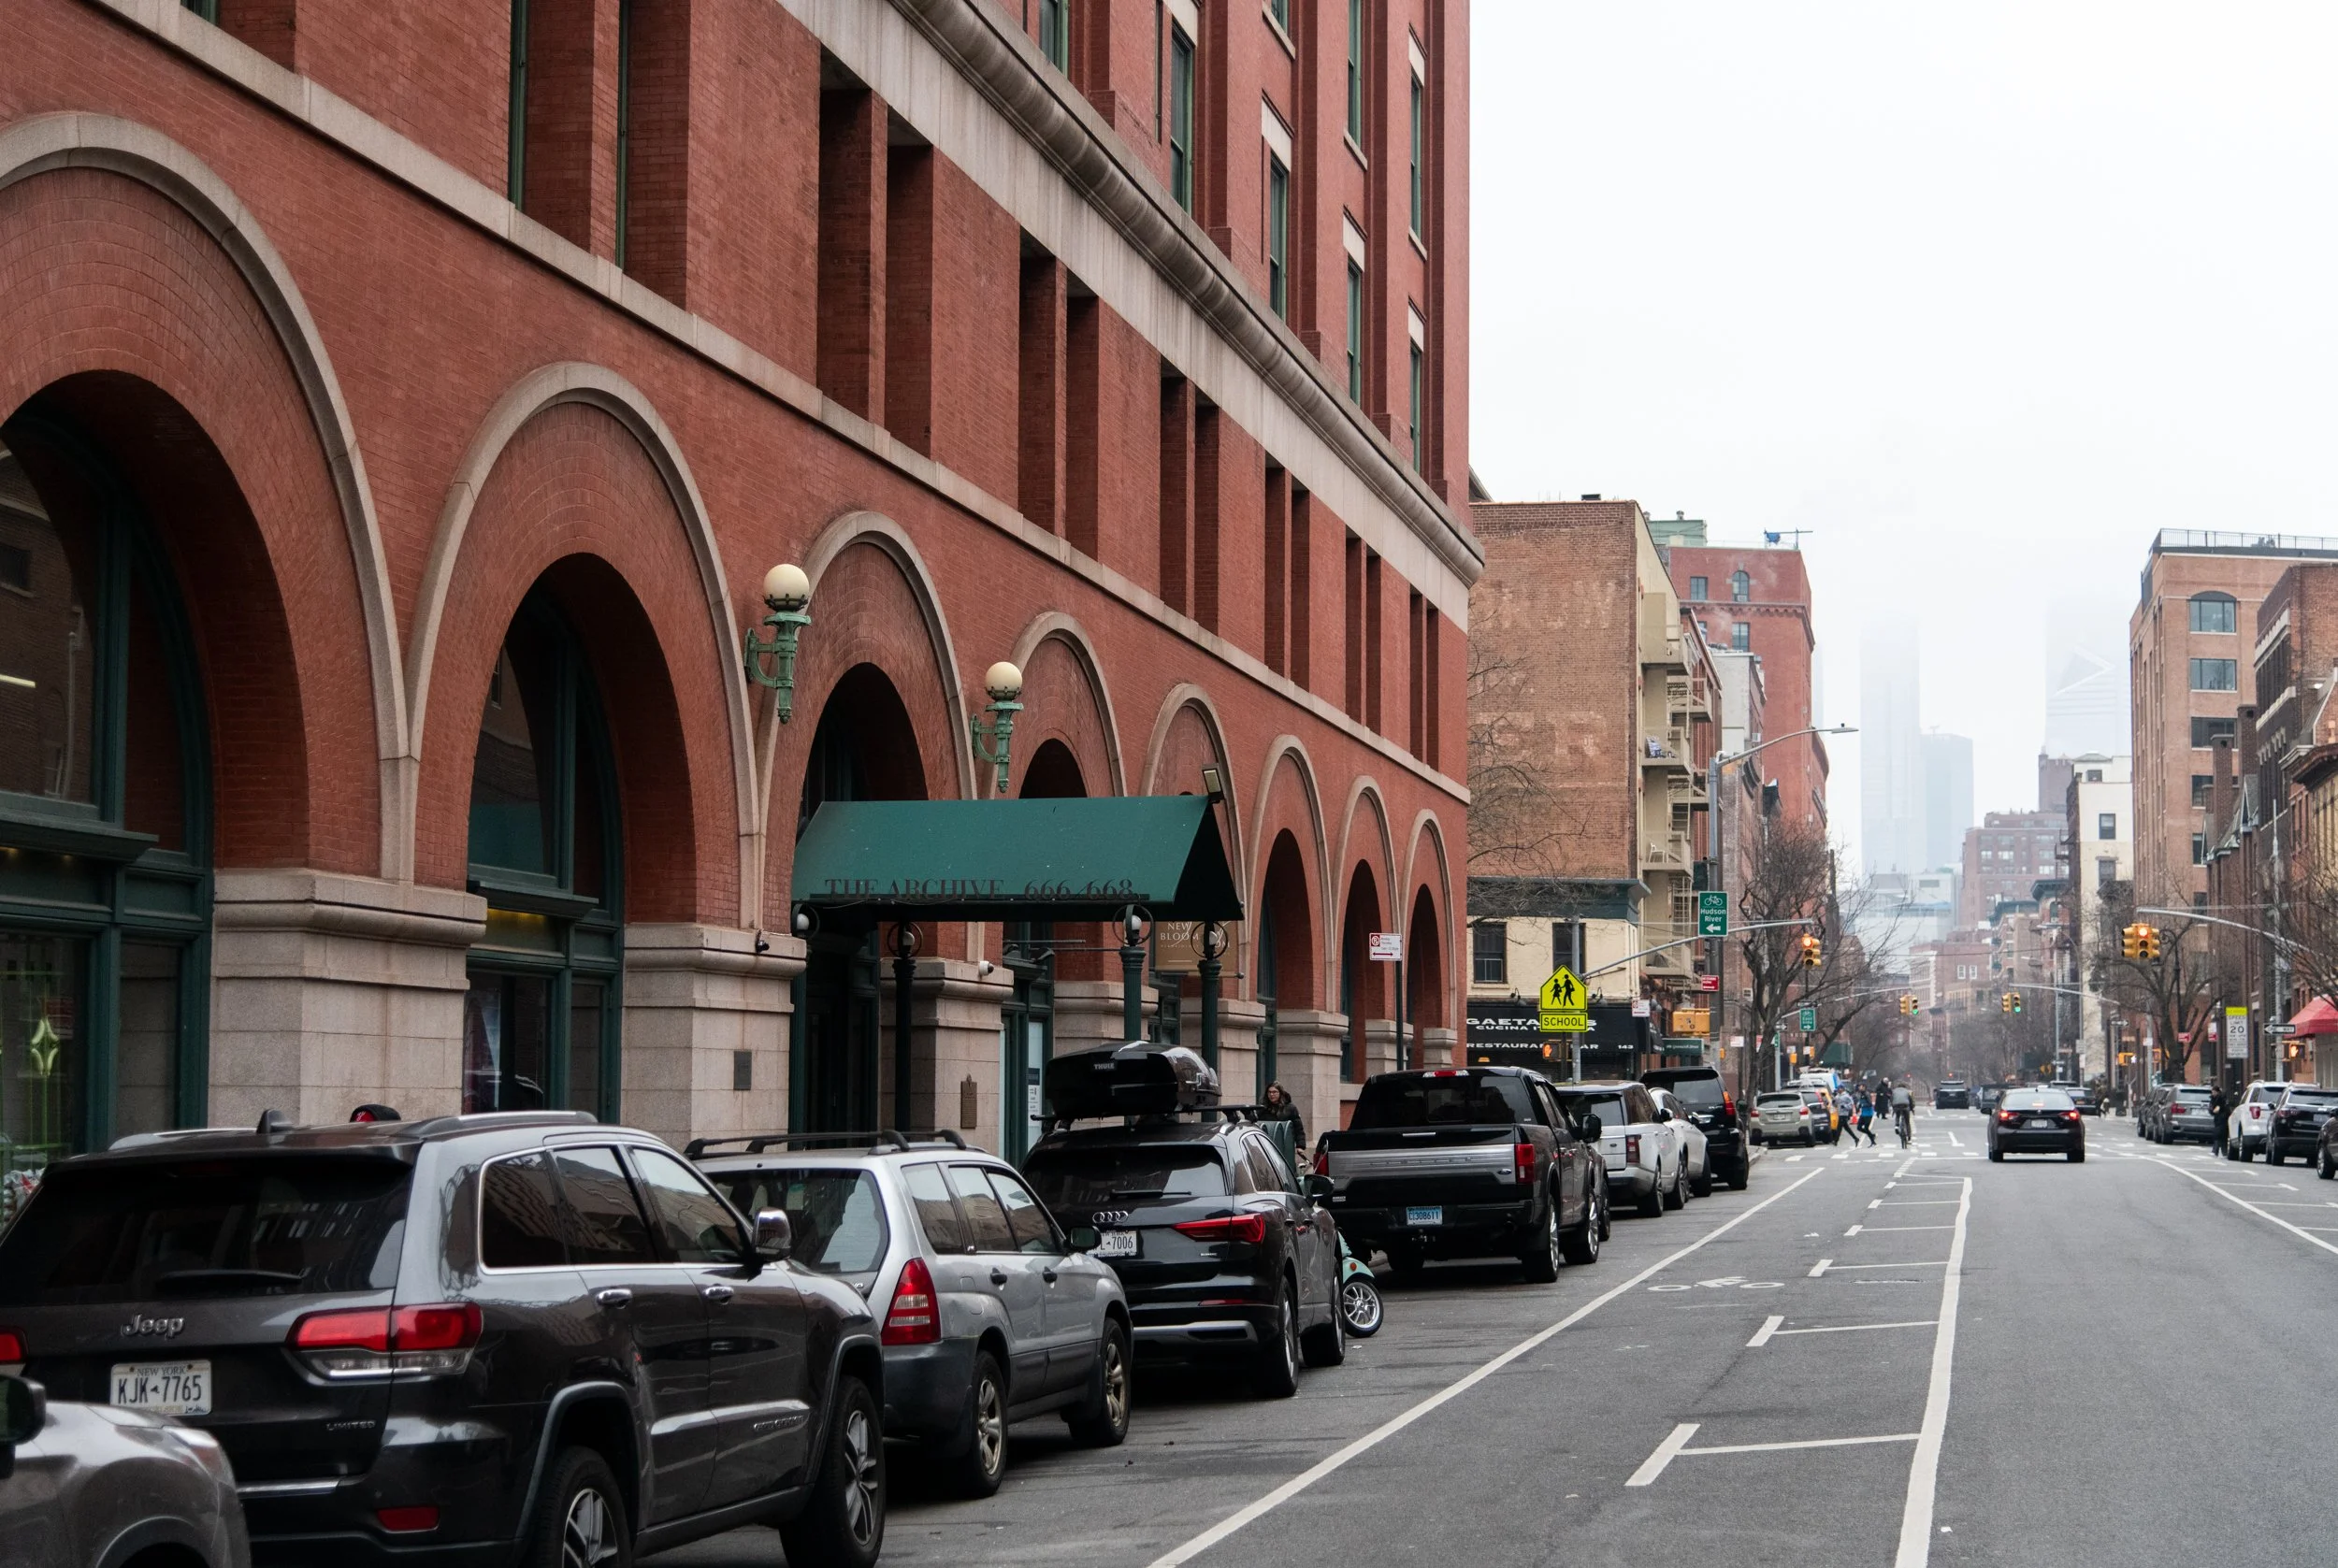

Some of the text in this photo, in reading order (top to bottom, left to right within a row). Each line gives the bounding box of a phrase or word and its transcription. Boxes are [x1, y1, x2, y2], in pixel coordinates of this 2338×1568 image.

[825, 879, 878, 899] THE
[889, 879, 1004, 899] ARCHIVE
[1543, 1016, 1584, 1027] SCHOOL
[120, 1314, 185, 1339] Jeep
[137, 1365, 186, 1376] NEW YORK
